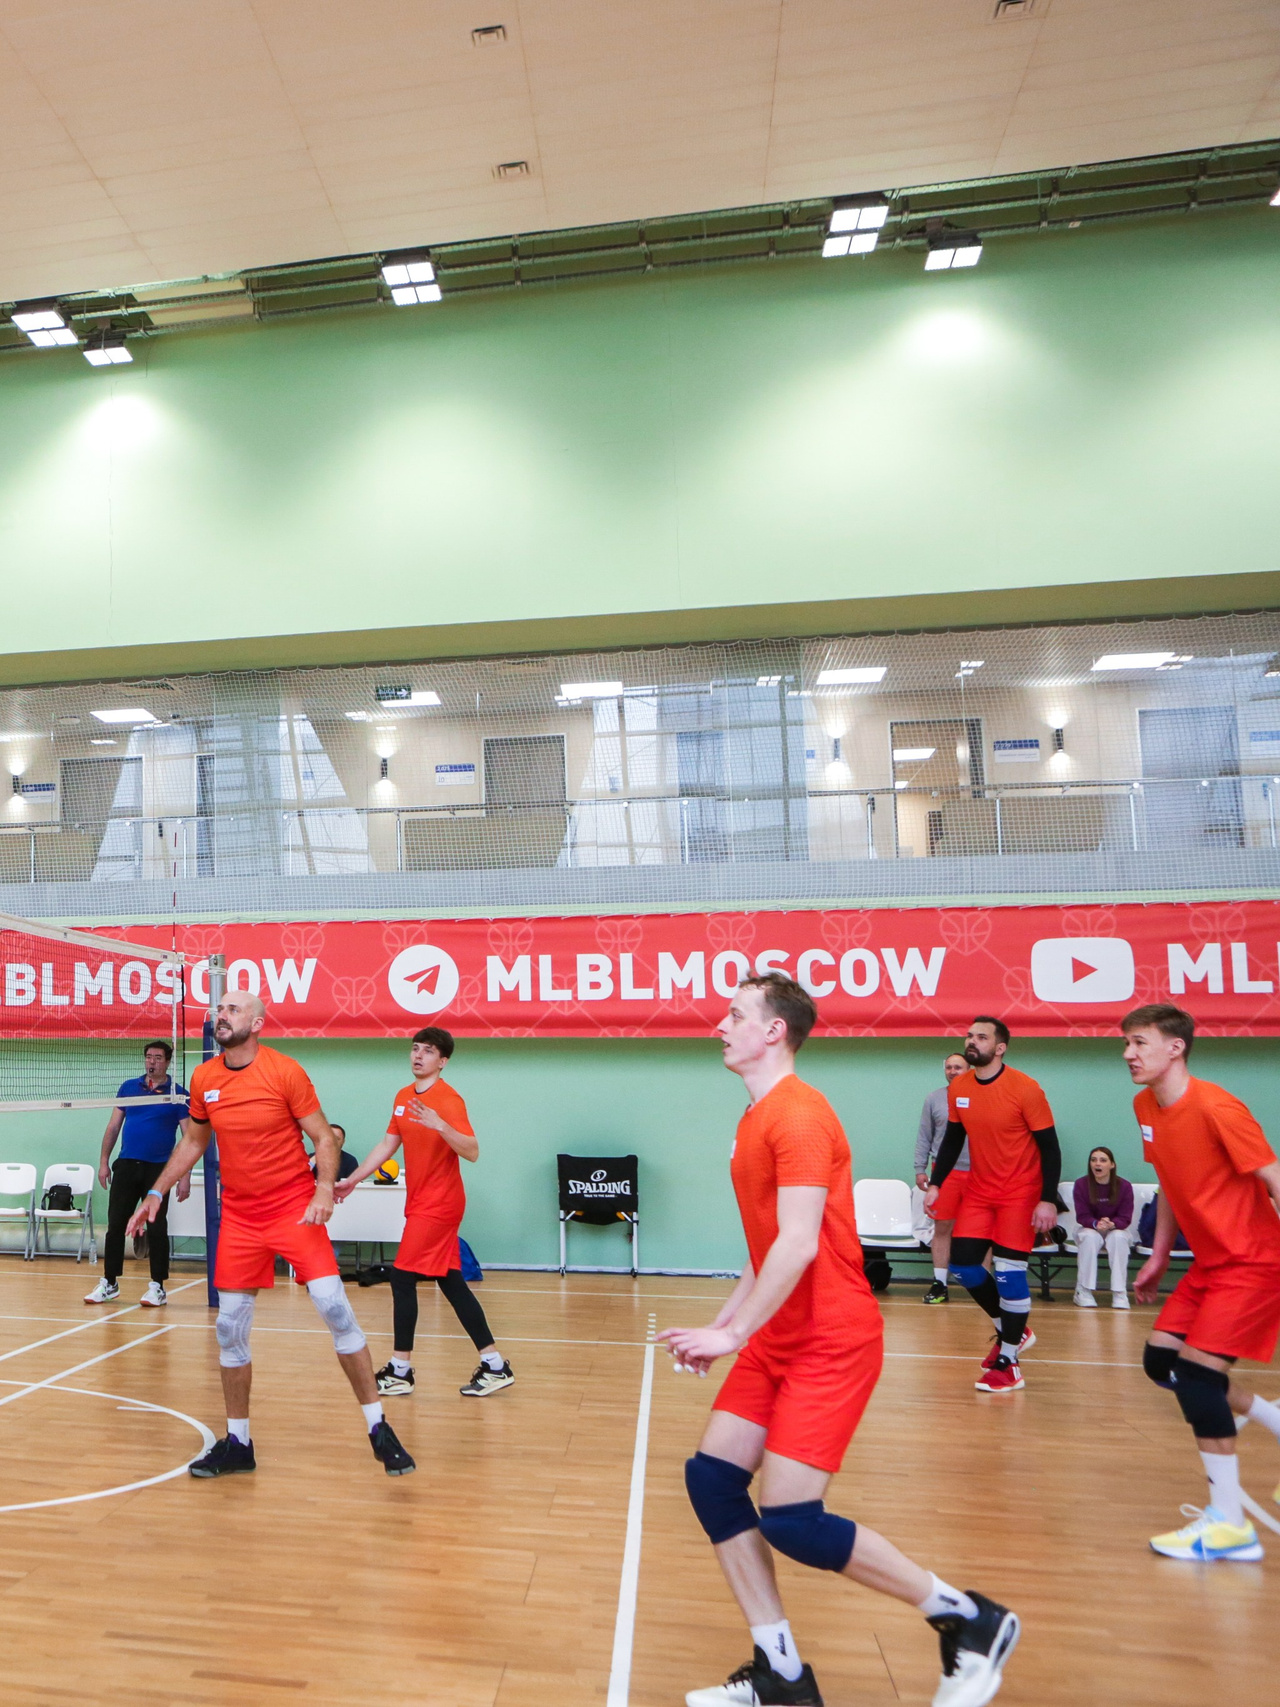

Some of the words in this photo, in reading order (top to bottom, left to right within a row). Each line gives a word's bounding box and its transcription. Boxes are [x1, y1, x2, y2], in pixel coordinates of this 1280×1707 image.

[486, 946, 947, 1002] MLBLMOSCOW
[1166, 941, 1280, 995] ML
[568, 1180, 632, 1195] SPALDING
